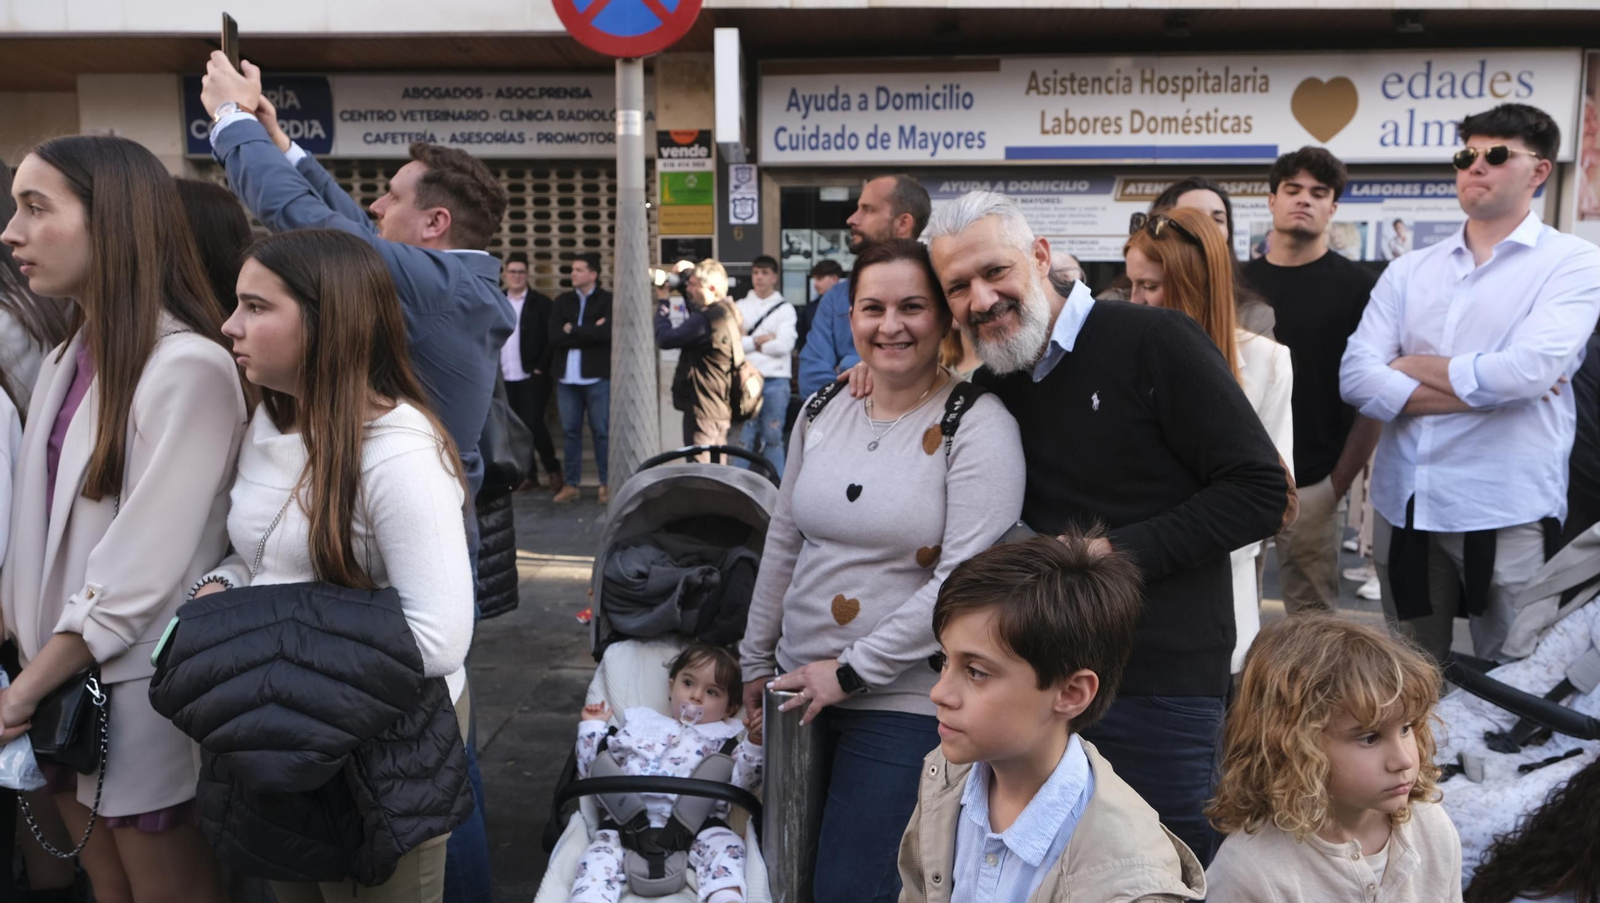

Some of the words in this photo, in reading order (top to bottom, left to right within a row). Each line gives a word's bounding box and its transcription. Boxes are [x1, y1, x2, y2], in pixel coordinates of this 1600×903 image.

[1025, 68, 1133, 96] Asistencia
[1140, 66, 1269, 102] Hospitalaria
[1381, 60, 1534, 100] edades
[402, 87, 483, 100] ABOGADOS
[786, 85, 852, 119] Ayuda
[858, 93, 869, 112] a
[875, 84, 975, 112] Domicilio
[340, 110, 396, 122] CENTRO
[400, 110, 489, 122] VETERINARIO
[499, 106, 554, 122] CLÍNICA
[1040, 108, 1123, 136] Labores
[1130, 107, 1253, 135] Domésticas
[363, 130, 437, 144] CAFETERÍA
[449, 129, 525, 143] ASESORÍAS
[1380, 108, 1461, 148] alm
[660, 143, 709, 158] vende
[774, 124, 860, 151] Cuidado
[866, 124, 892, 150] de
[898, 124, 986, 157] Mayores
[939, 181, 991, 193] AYUDA
[992, 181, 1005, 192] A
[1008, 180, 1090, 192] DOMICILIO
[1351, 183, 1421, 196] LABORES
